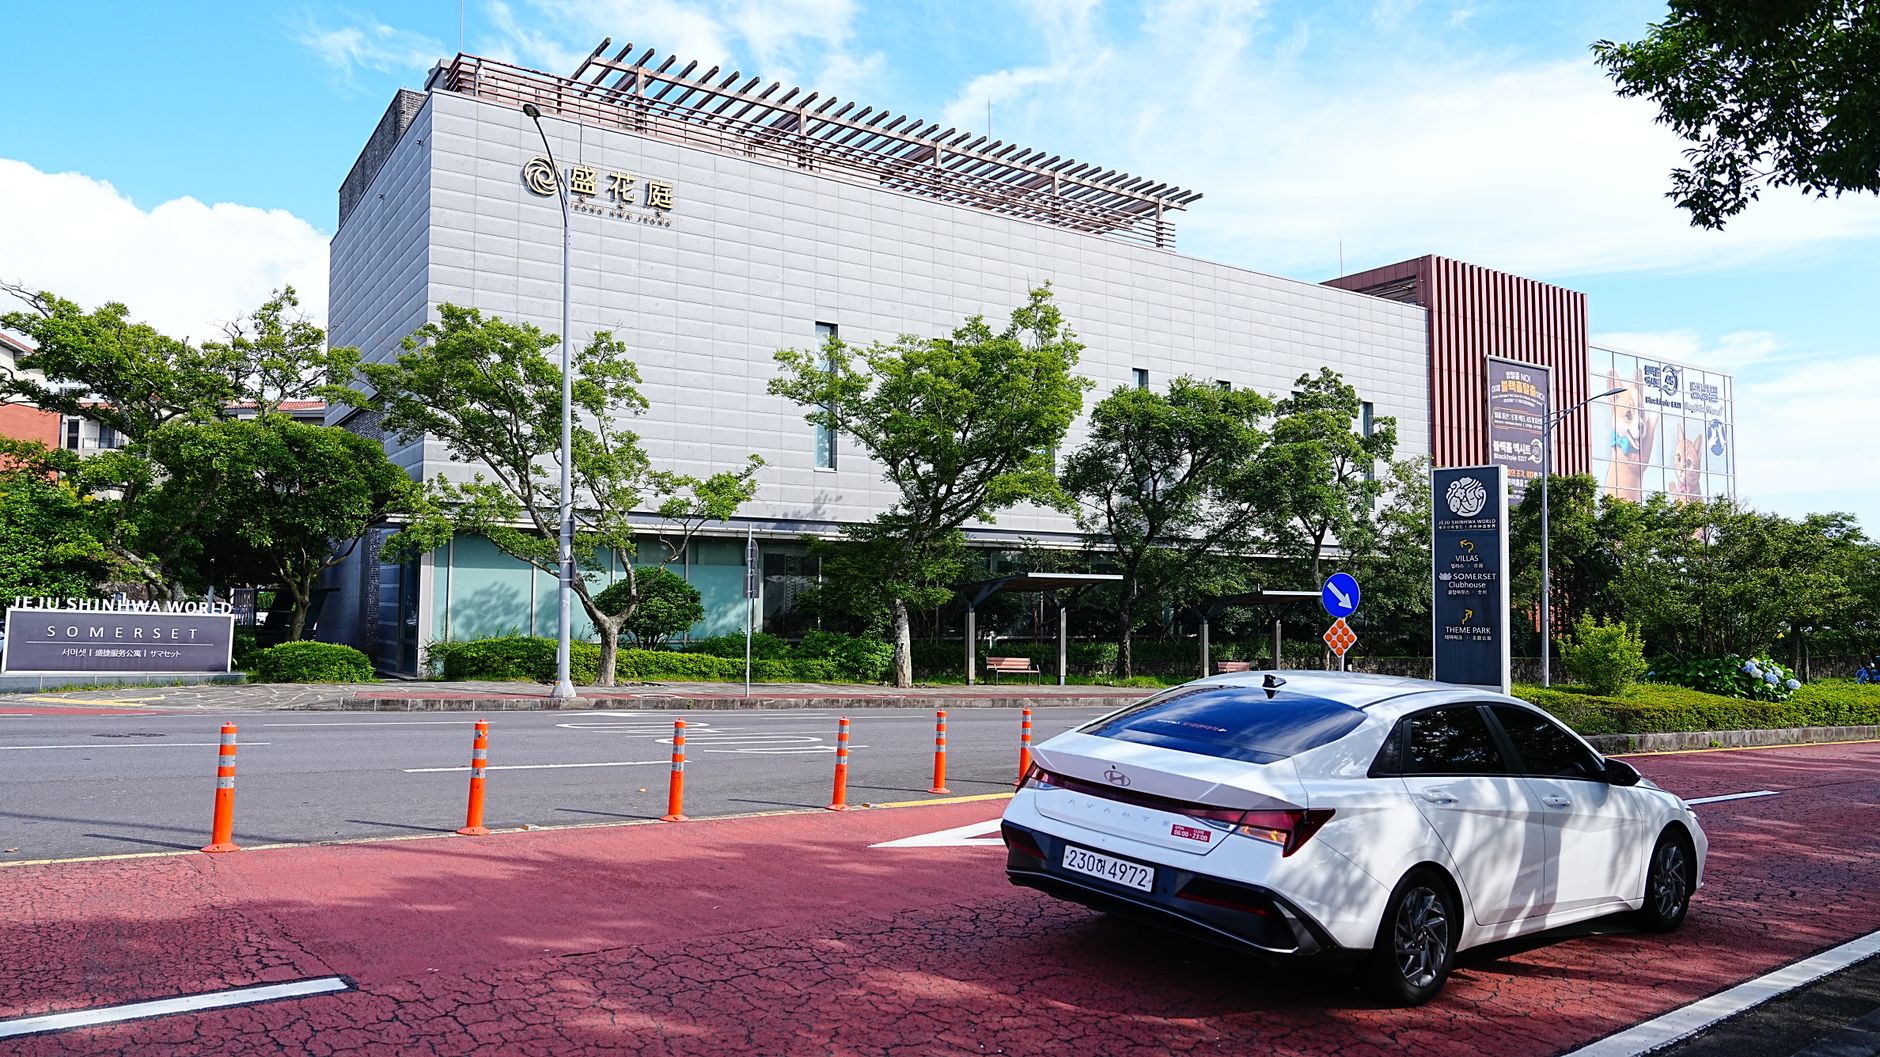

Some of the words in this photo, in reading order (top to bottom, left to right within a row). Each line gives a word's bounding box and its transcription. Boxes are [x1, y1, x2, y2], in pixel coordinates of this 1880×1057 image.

[570, 165, 674, 210] 盛花庭
[1448, 581, 1486, 589] Clubhouse
[10, 596, 59, 610] JEJU
[66, 597, 161, 613] SHINHWA
[166, 601, 233, 615] WORLD
[46, 625, 198, 640] SOMERSET
[1445, 626, 1471, 634] THEME
[1472, 626, 1491, 634] PARK
[62, 649, 87, 657] 서머셋
[150, 650, 181, 658] サマセット
[1068, 798, 1170, 826] AVANTE
[1068, 850, 1106, 875] 230허
[1108, 861, 1148, 888] 4972
